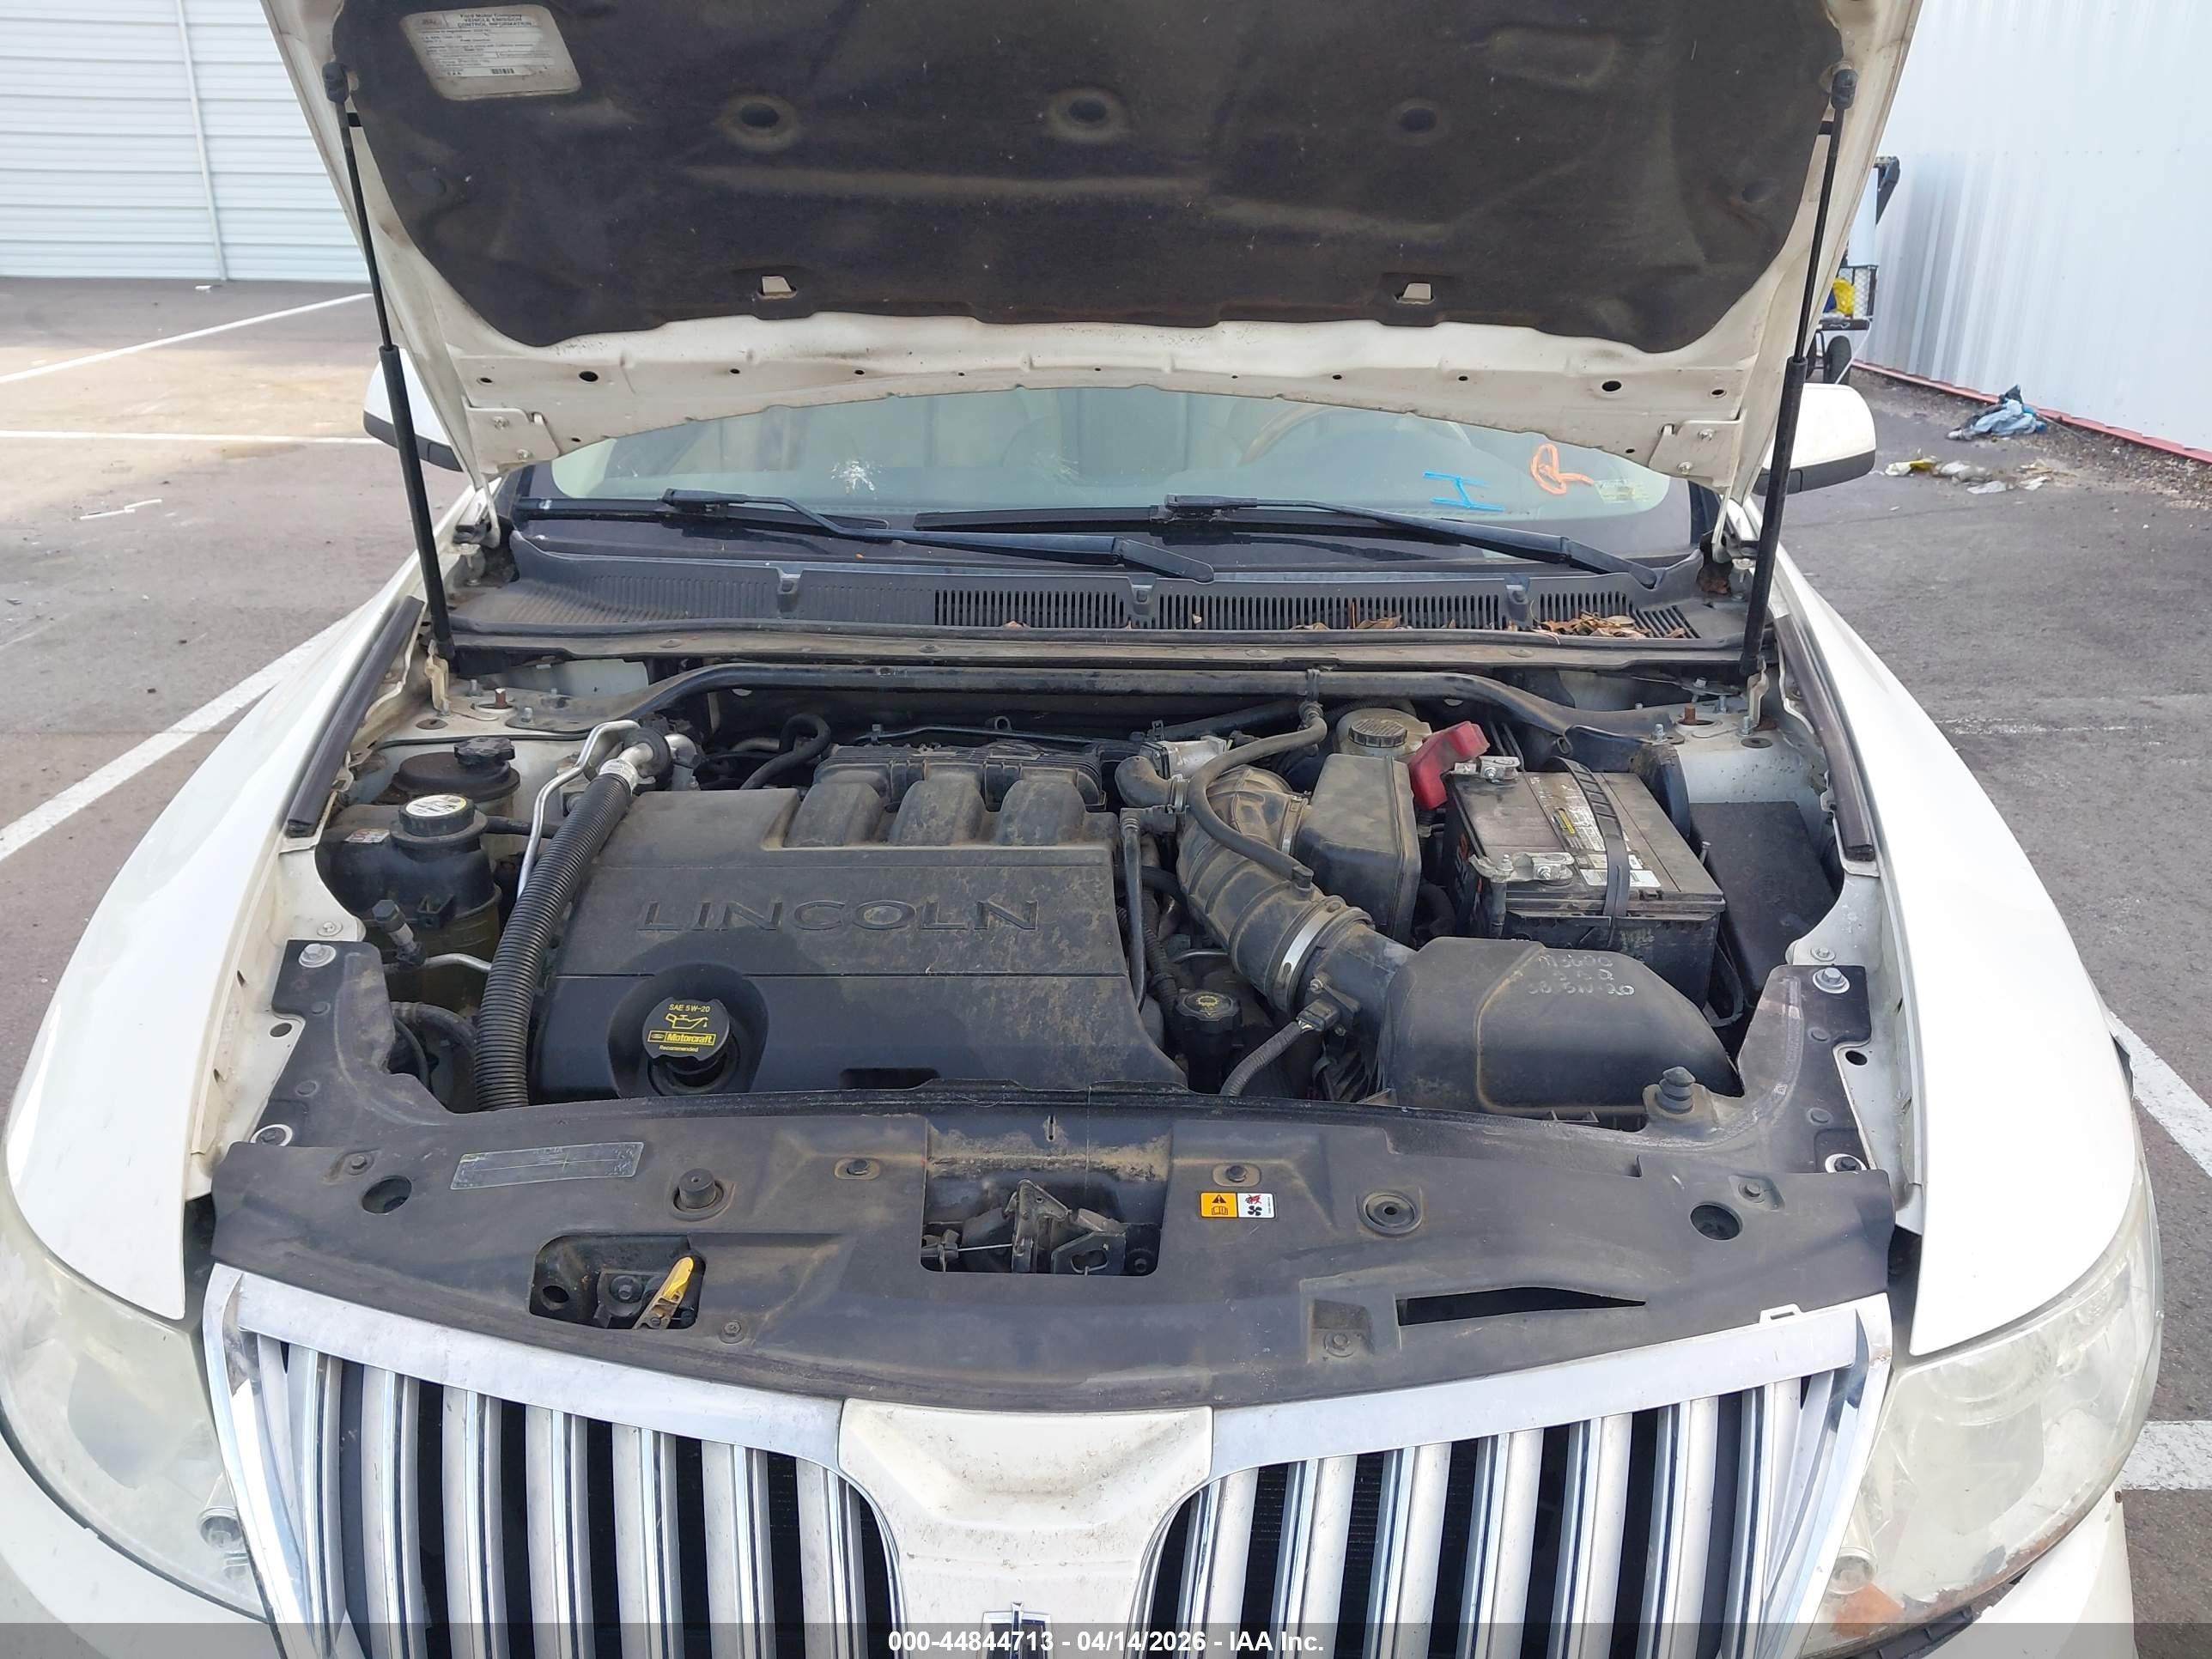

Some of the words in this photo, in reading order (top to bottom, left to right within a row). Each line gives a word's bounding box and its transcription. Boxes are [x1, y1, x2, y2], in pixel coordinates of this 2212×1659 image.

[636, 899, 1039, 932] LINCOLN
[669, 1003, 684, 1012] SAE
[685, 1004, 711, 1012] 5W-20
[667, 1033, 713, 1043] Motorcraft
[659, 1044, 699, 1053] Recommended
